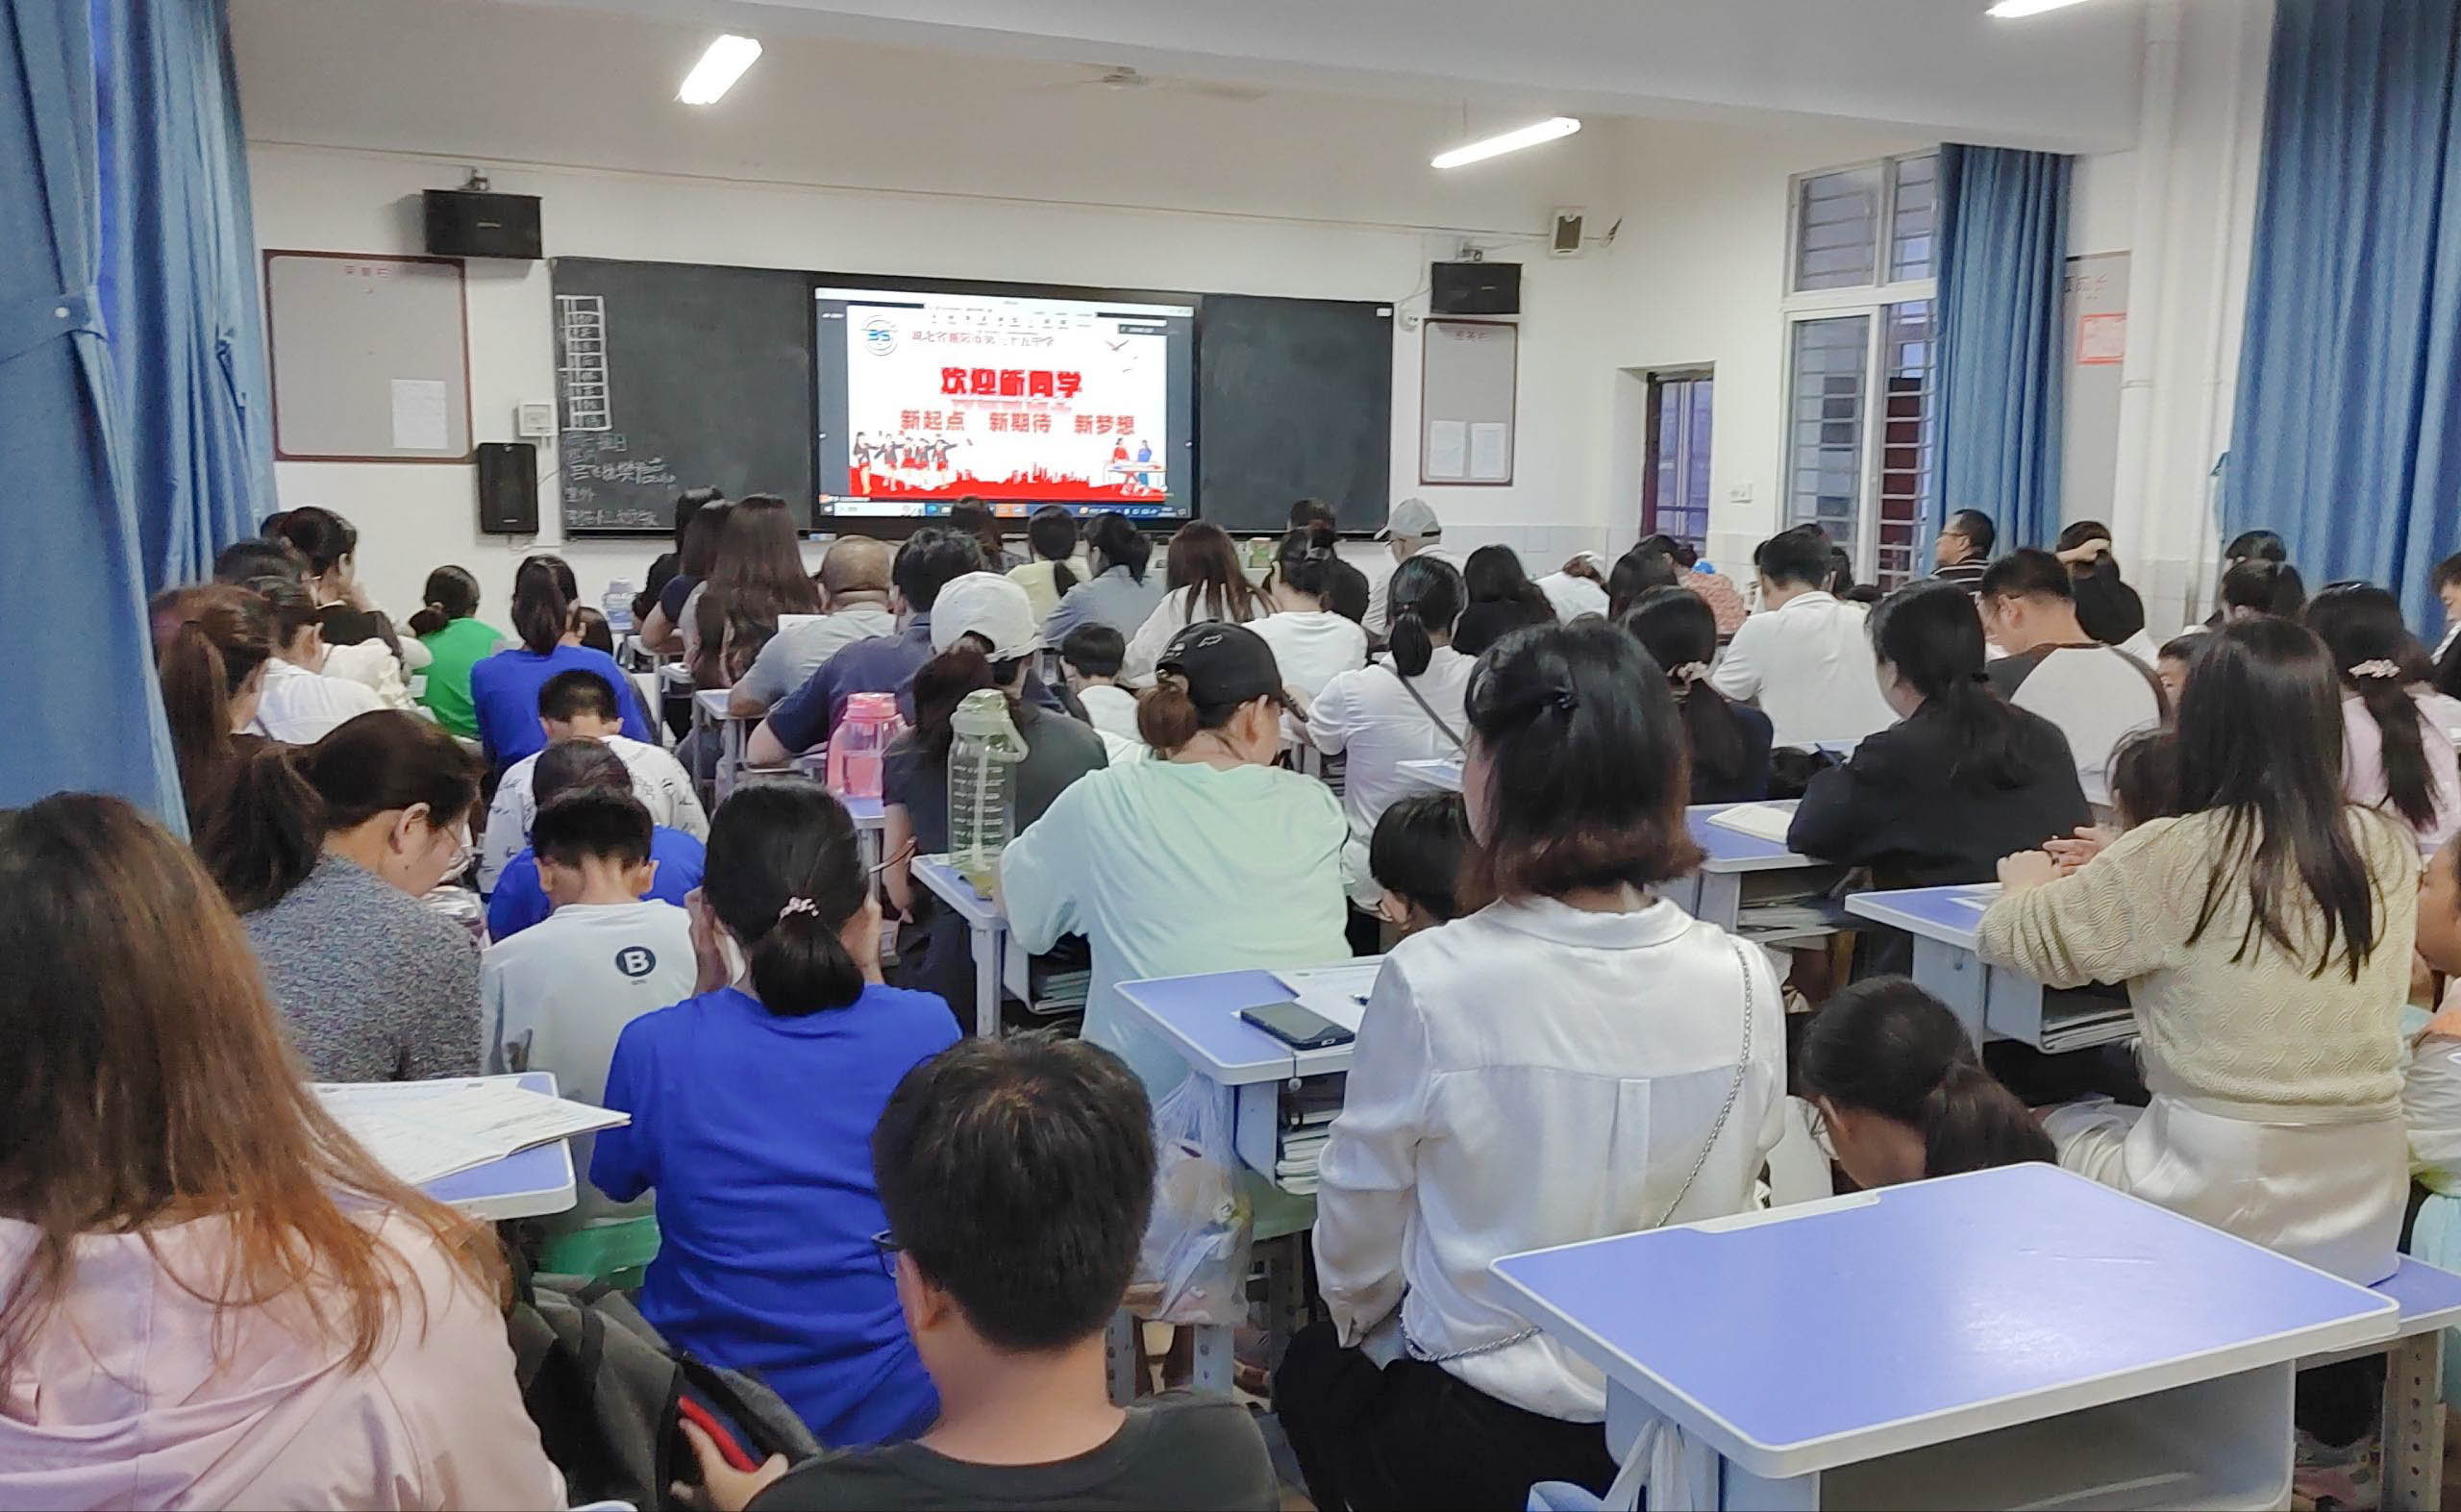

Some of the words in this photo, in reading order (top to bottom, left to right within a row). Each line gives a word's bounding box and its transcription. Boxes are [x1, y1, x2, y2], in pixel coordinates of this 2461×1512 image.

[940, 367, 1082, 399] 欢迎新同学
[901, 409, 965, 432] 新起点
[989, 411, 1052, 434] 新期待
[1074, 414, 1135, 436] 新梦想
